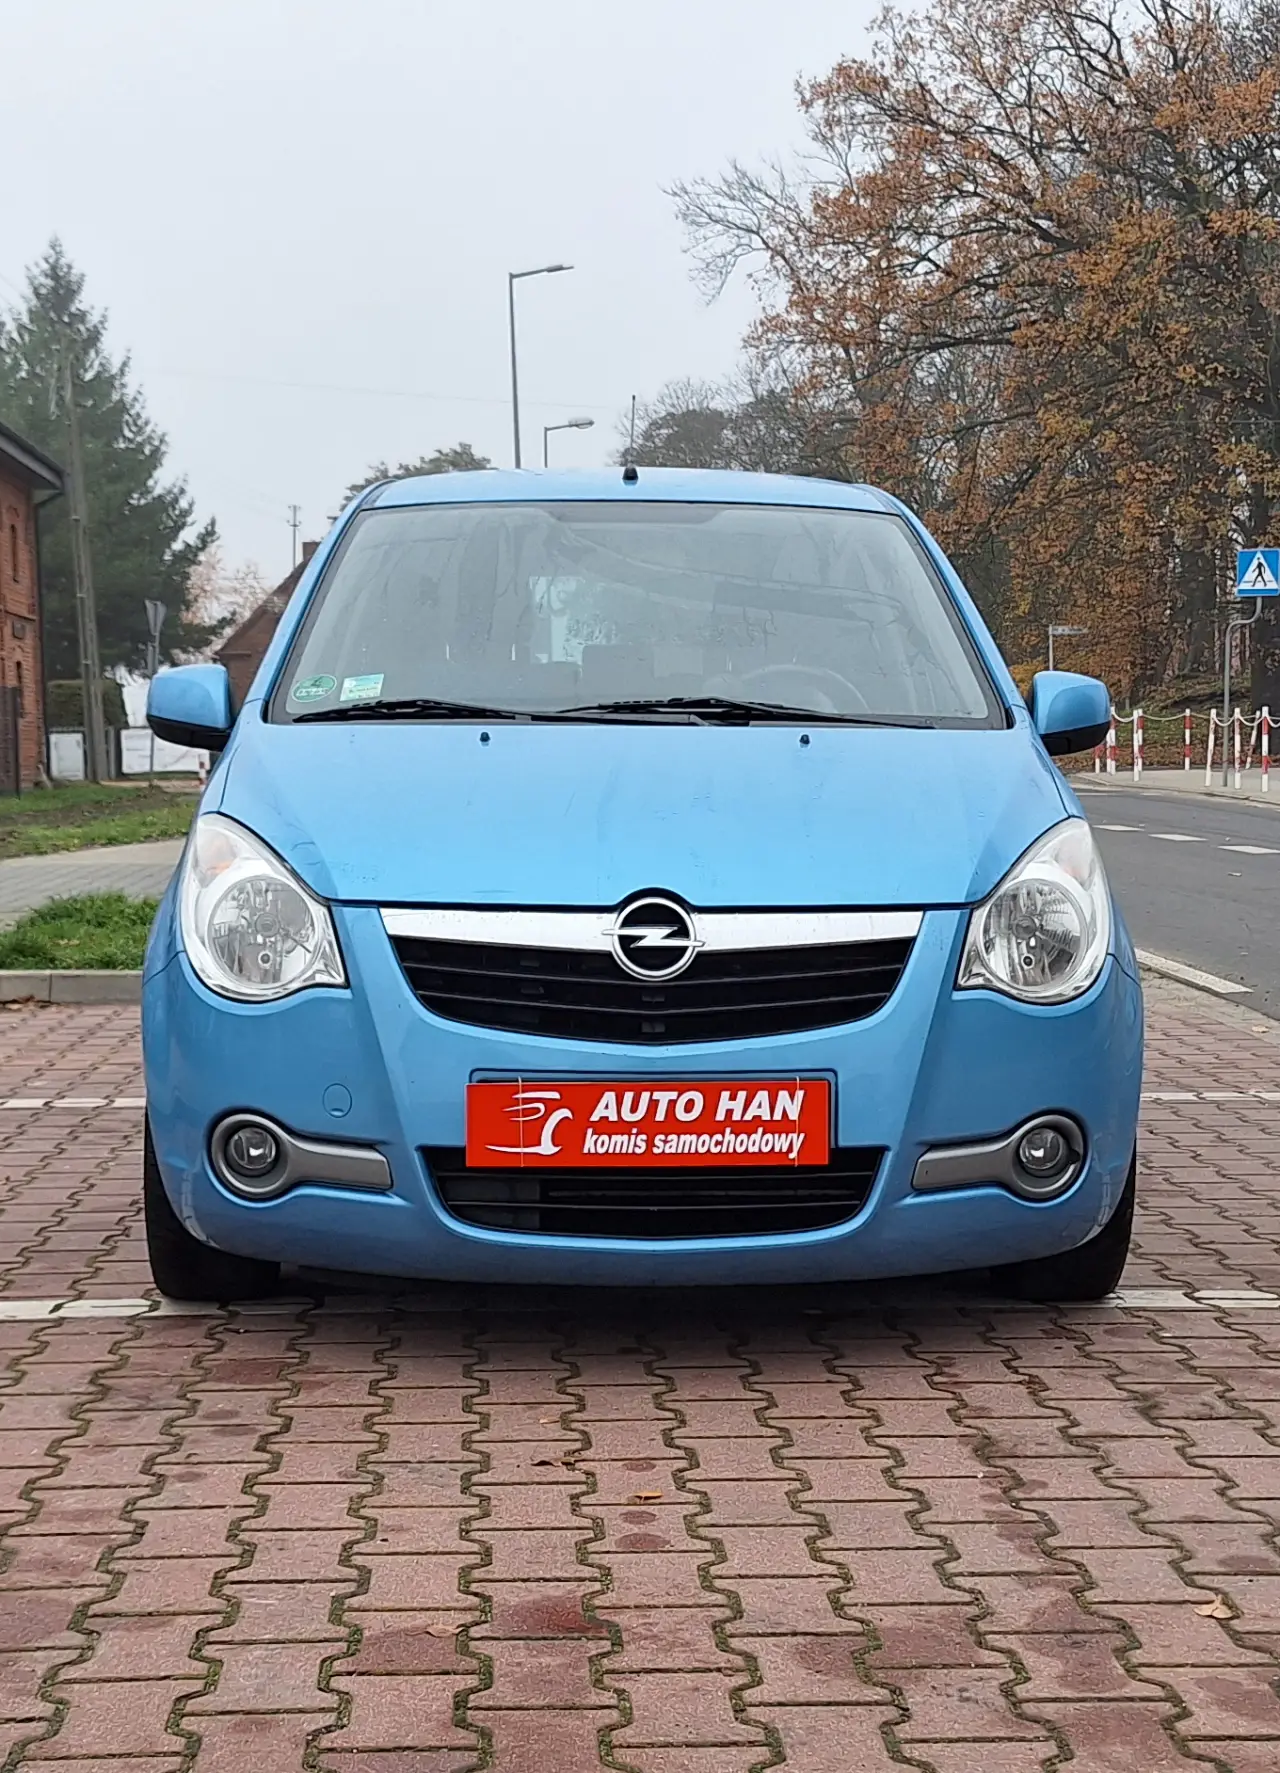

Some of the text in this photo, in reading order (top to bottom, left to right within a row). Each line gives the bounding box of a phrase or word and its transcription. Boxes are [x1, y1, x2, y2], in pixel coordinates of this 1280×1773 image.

[589, 1089, 805, 1122] AUTO HAN
[582, 1127, 805, 1160] komis samochodowy
